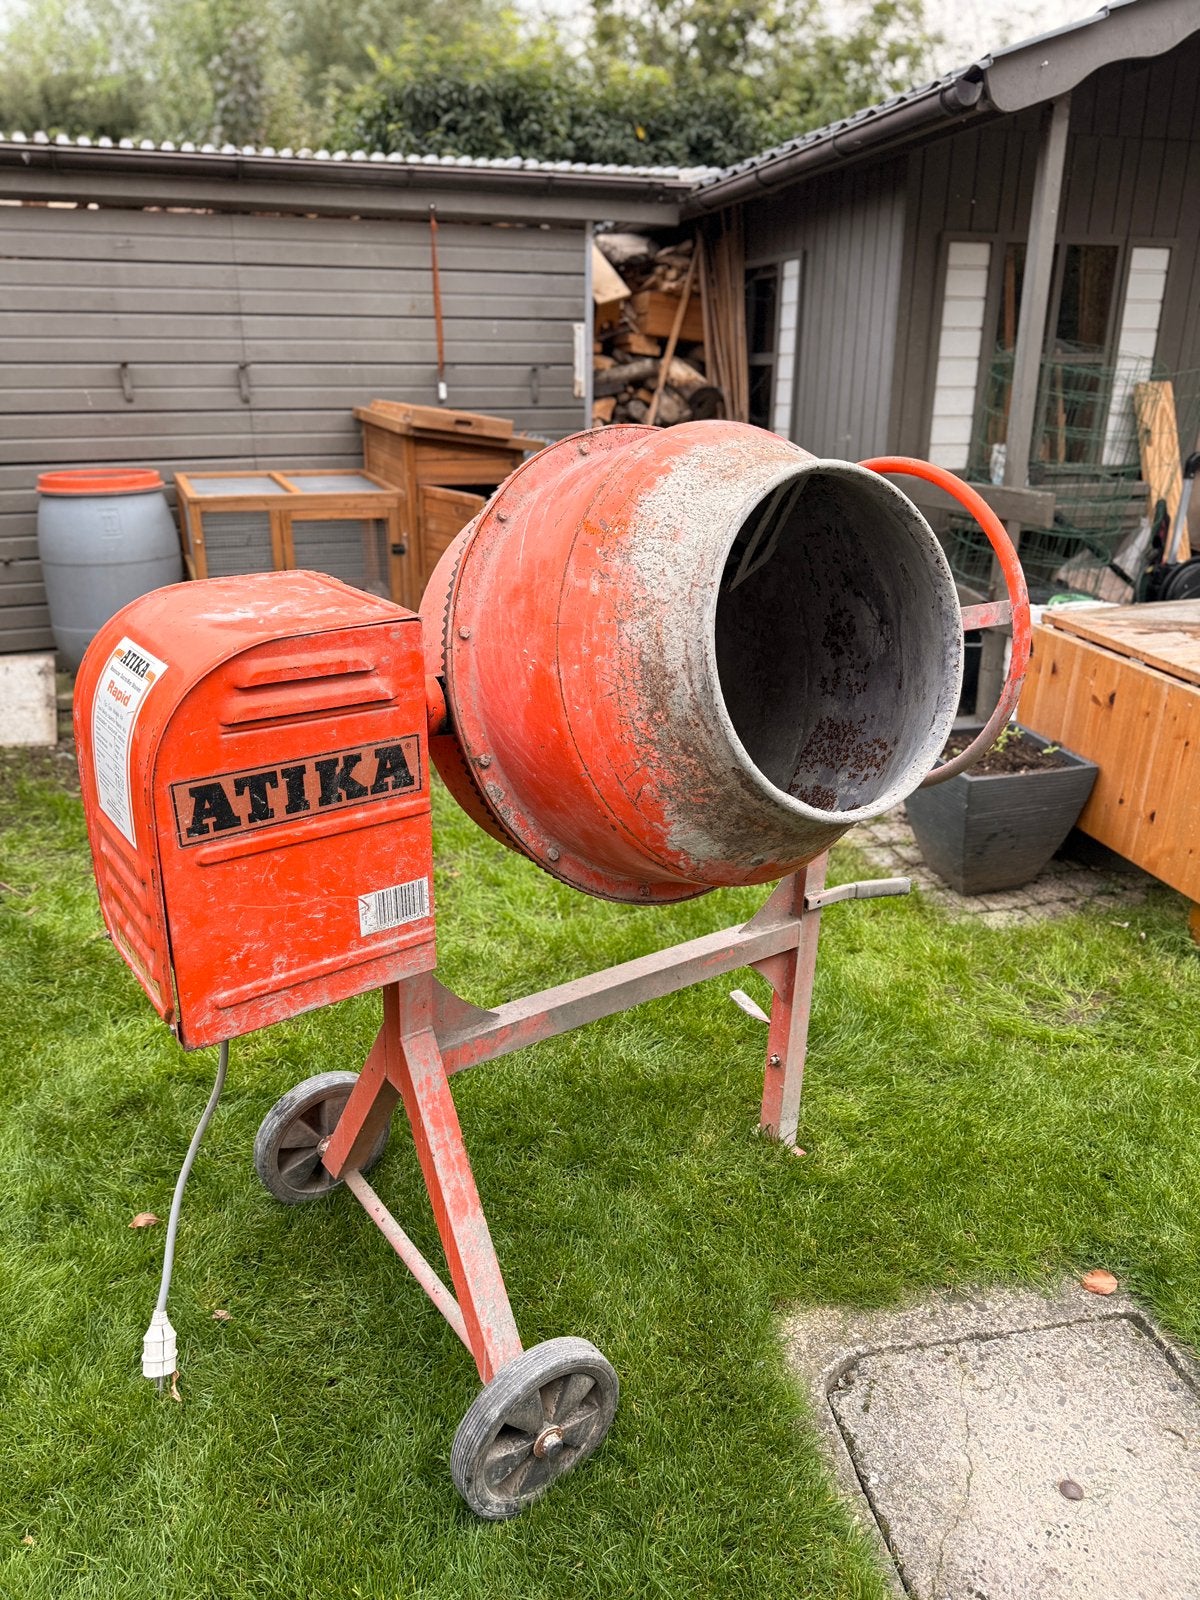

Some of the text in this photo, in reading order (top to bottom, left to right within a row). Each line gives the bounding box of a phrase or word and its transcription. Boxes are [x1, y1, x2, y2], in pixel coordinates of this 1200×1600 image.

[120, 649, 150, 678] ATIKA
[107, 679, 131, 707] Rapid
[187, 744, 414, 838] ATIKA
